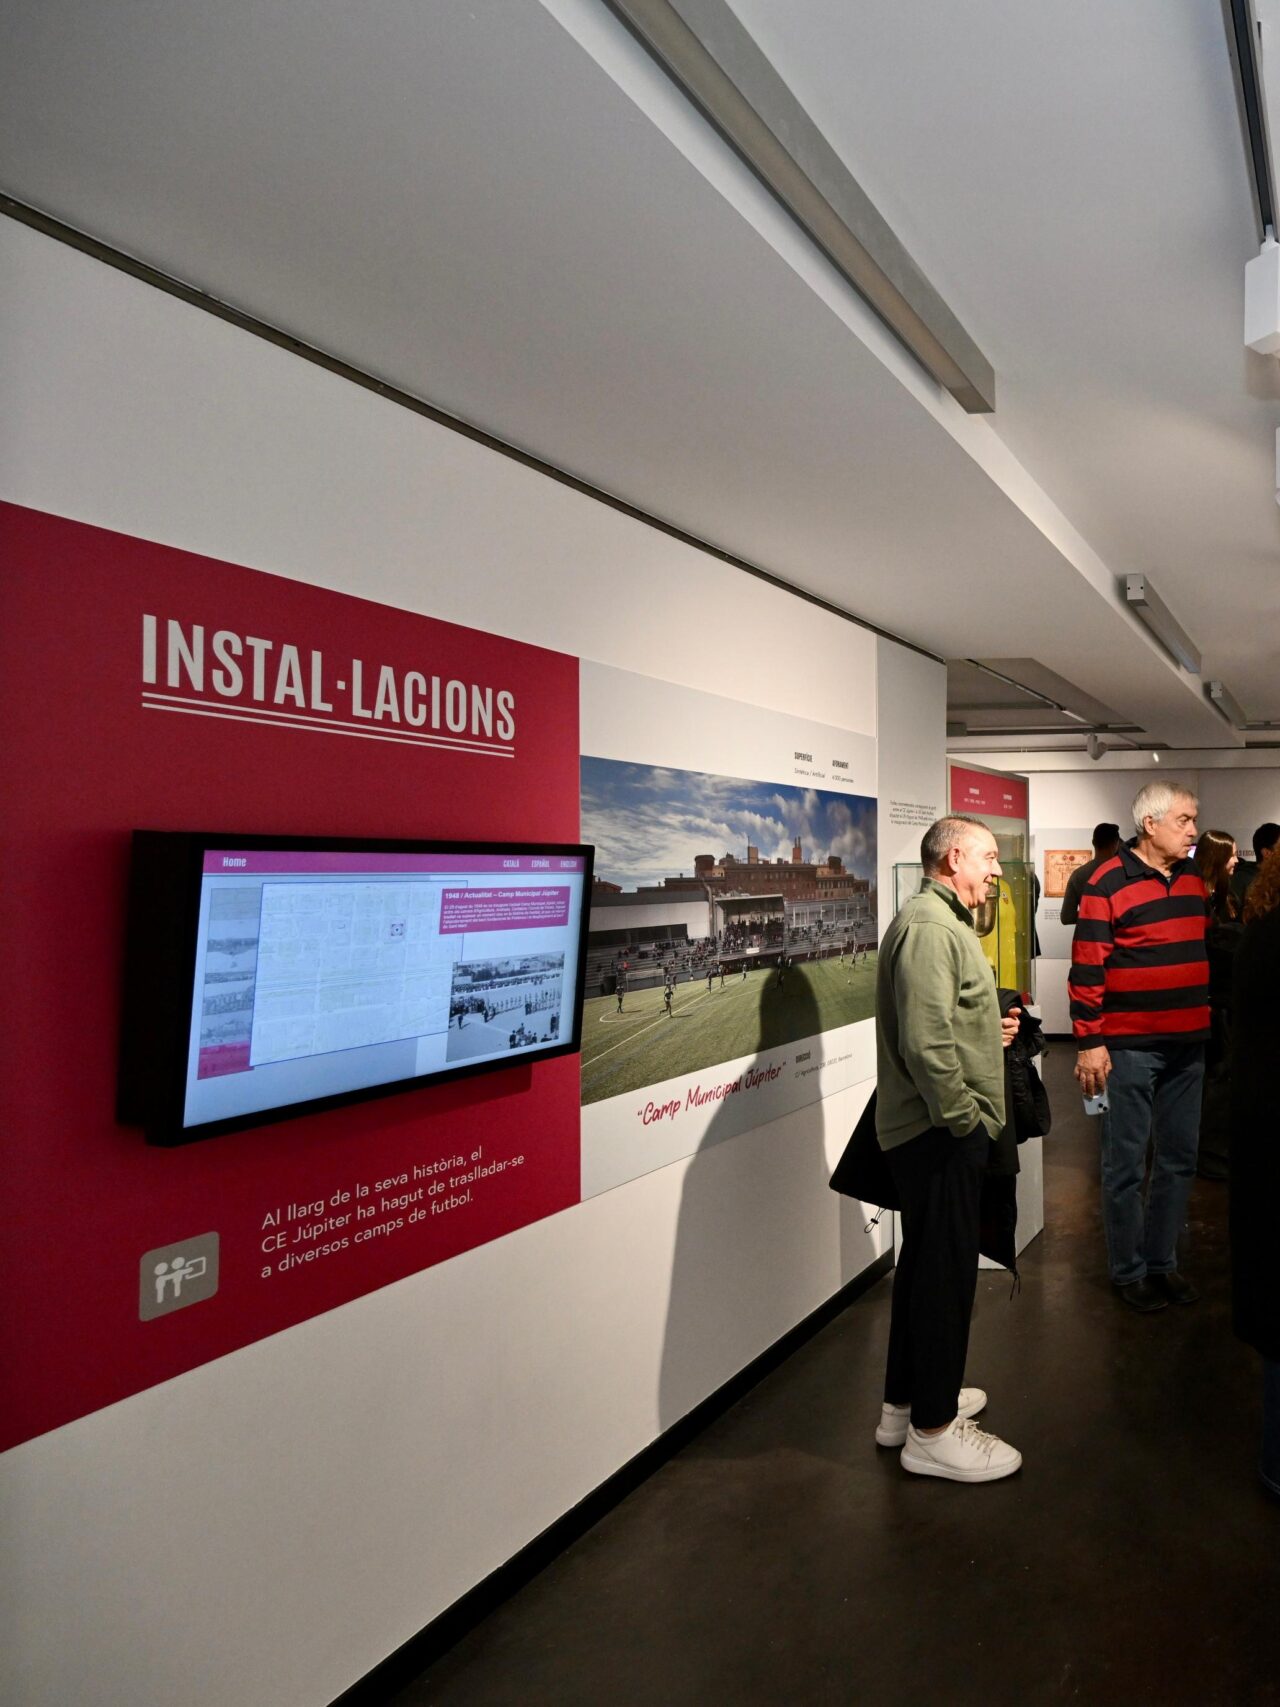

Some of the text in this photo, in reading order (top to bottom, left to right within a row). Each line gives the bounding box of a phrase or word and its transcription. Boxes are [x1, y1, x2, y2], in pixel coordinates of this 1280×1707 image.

[223, 856, 247, 868] Home
[685, 1074, 742, 1111] Municipal
[261, 1155, 525, 1253] CE Júpiter ha hagut de traslladar-se
[262, 1145, 482, 1230] Al llarg de la seva història, el
[261, 1189, 473, 1278] a diversos camps de futbol.
